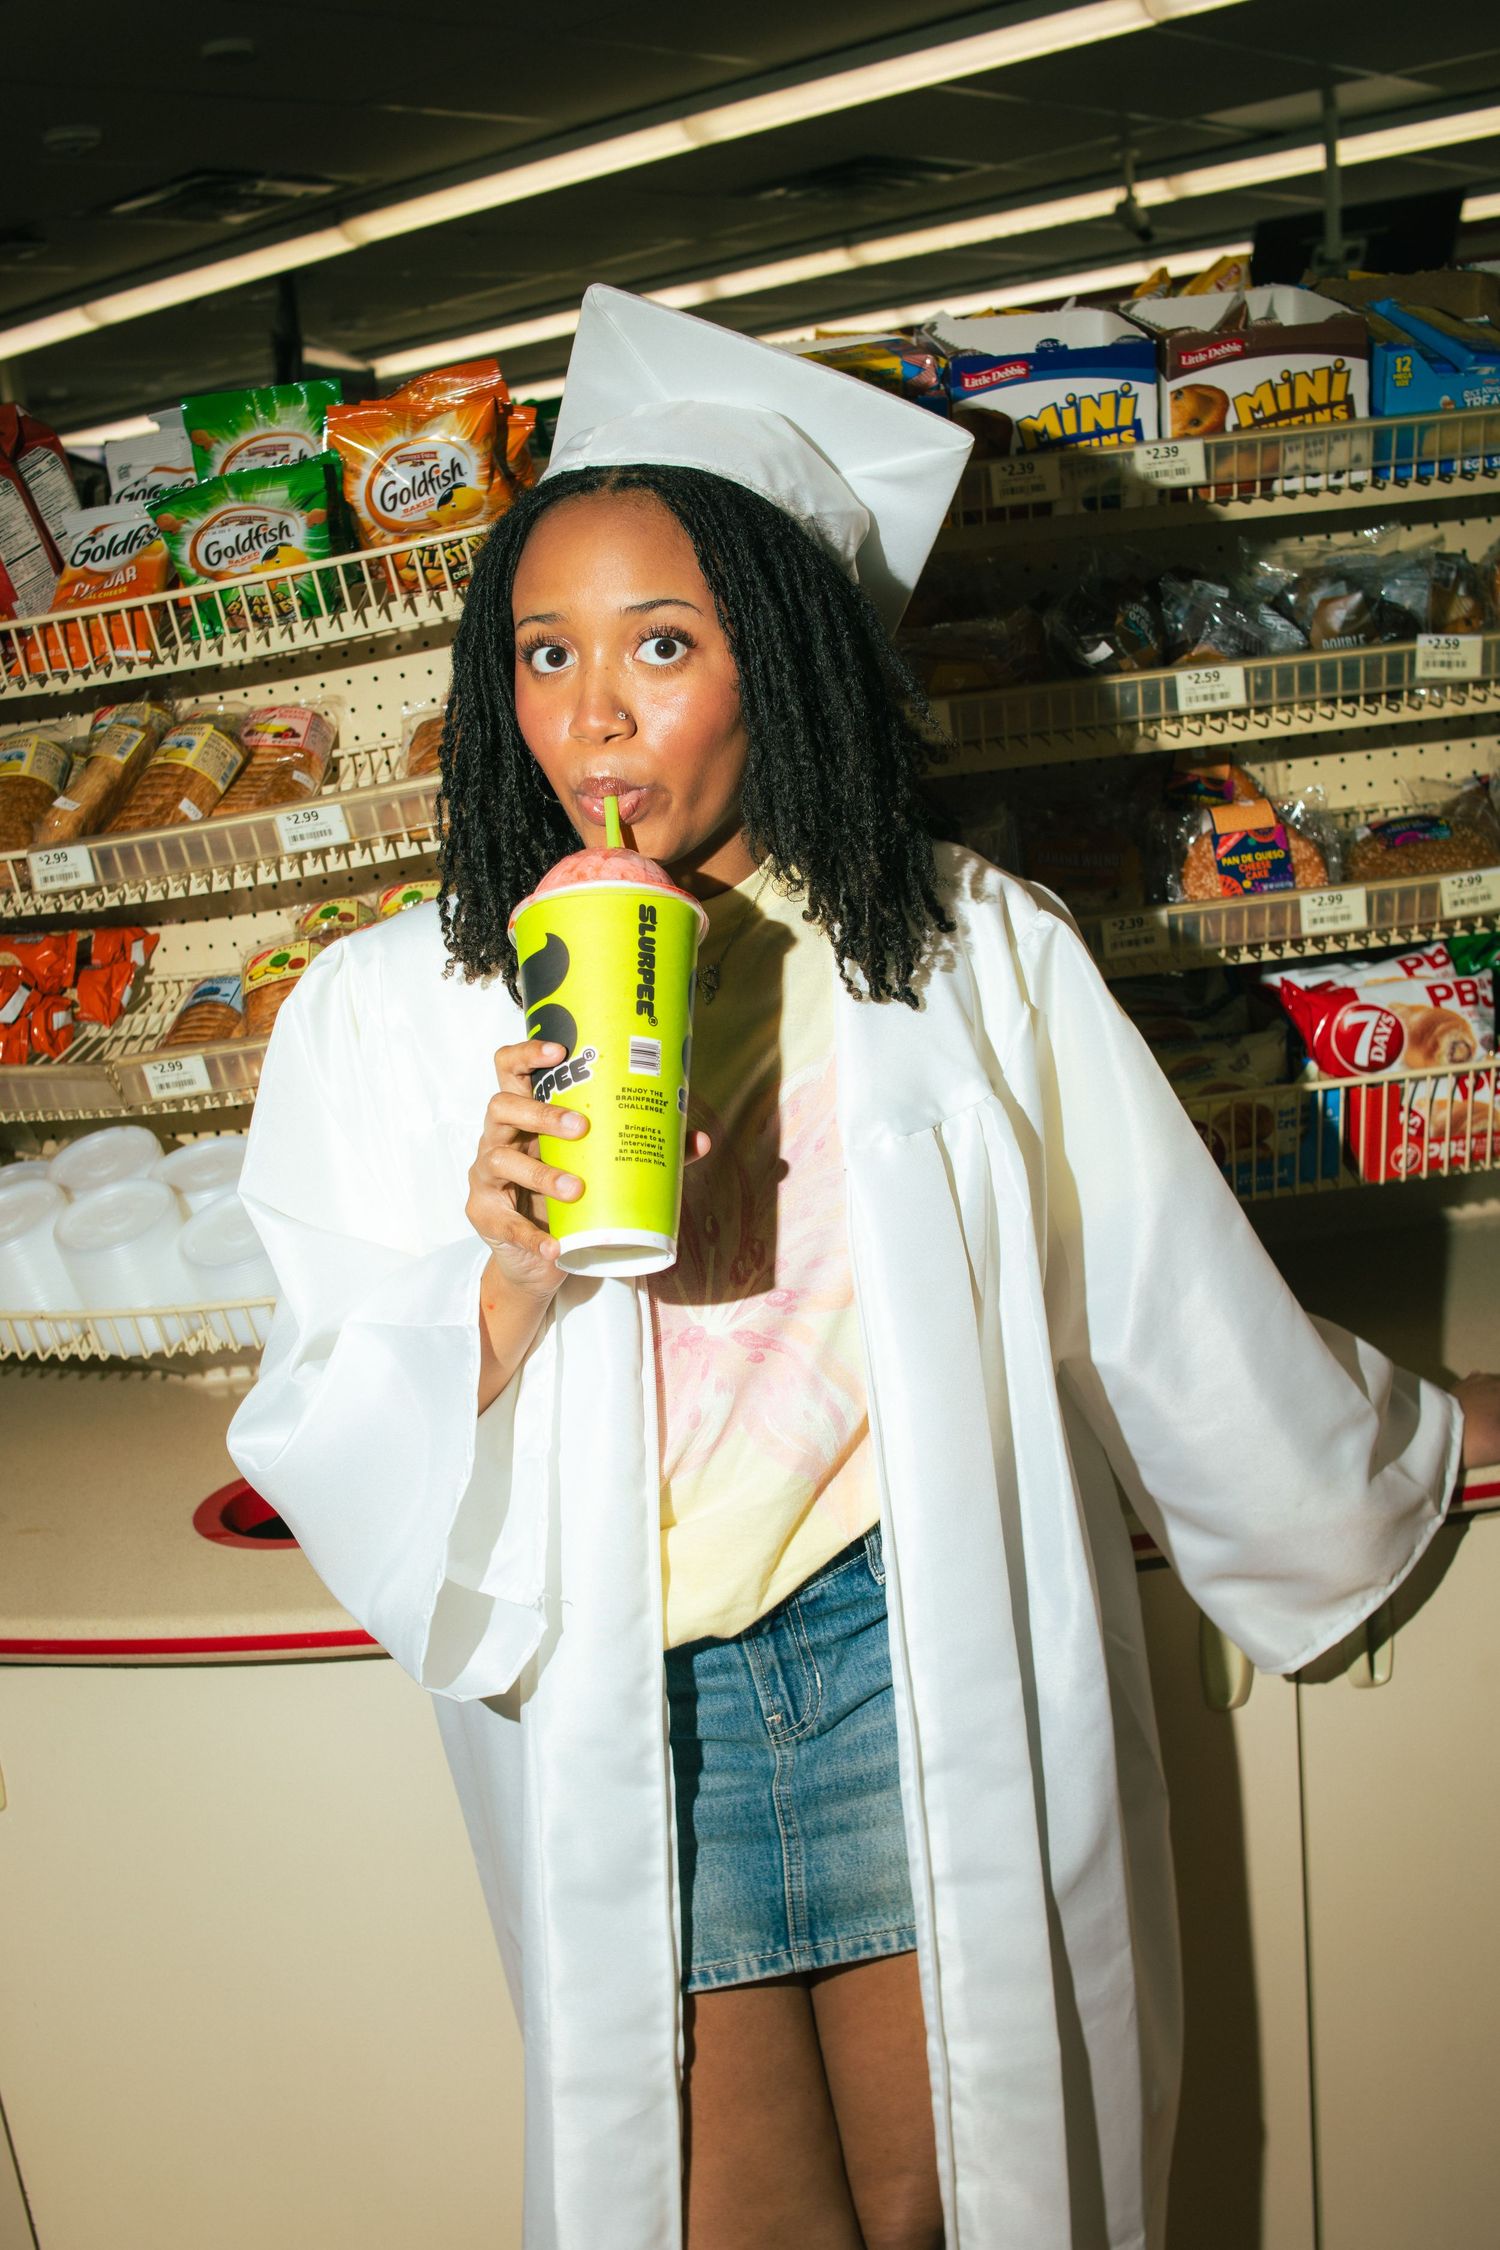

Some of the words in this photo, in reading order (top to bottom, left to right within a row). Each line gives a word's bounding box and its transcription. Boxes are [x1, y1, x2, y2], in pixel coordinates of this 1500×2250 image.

[1180, 351, 1207, 366] Little
[1208, 343, 1243, 360] Debbie
[1395, 355, 1412, 373] 12
[964, 371, 991, 389] Little
[992, 364, 1027, 384] Debbie
[1145, 446, 1179, 460] $2.39
[380, 457, 464, 513] Goldfish
[69, 524, 160, 569] Goldfis
[204, 520, 292, 567] Goldfish
[1187, 670, 1220, 685] $2.59
[286, 810, 319, 825] $2.99
[39, 851, 68, 865] $2.99
[1221, 855, 1240, 866] PAN
[1241, 853, 1253, 864] DE
[1254, 849, 1285, 861] QUESO
[1239, 860, 1272, 873] CHEESE
[1246, 869, 1269, 880] CAKE
[1311, 894, 1343, 907] $2.99
[1342, 1009, 1382, 1068] 7
[1369, 1012, 1396, 1064] DAYS
[152, 1060, 183, 1074] $2.99
[621, 1086, 648, 1095] ENJOY
[650, 1089, 664, 1098] THE
[618, 1102, 665, 1114] CHALLENGE.
[618, 1132, 648, 1140] Slurpee
[624, 1124, 656, 1134] Bringing
[621, 1139, 657, 1149] interview
[657, 1143, 663, 1151] is
[630, 1149, 665, 1159] automatic
[634, 1156, 652, 1164] dunk
[653, 1158, 667, 1168] hire.
